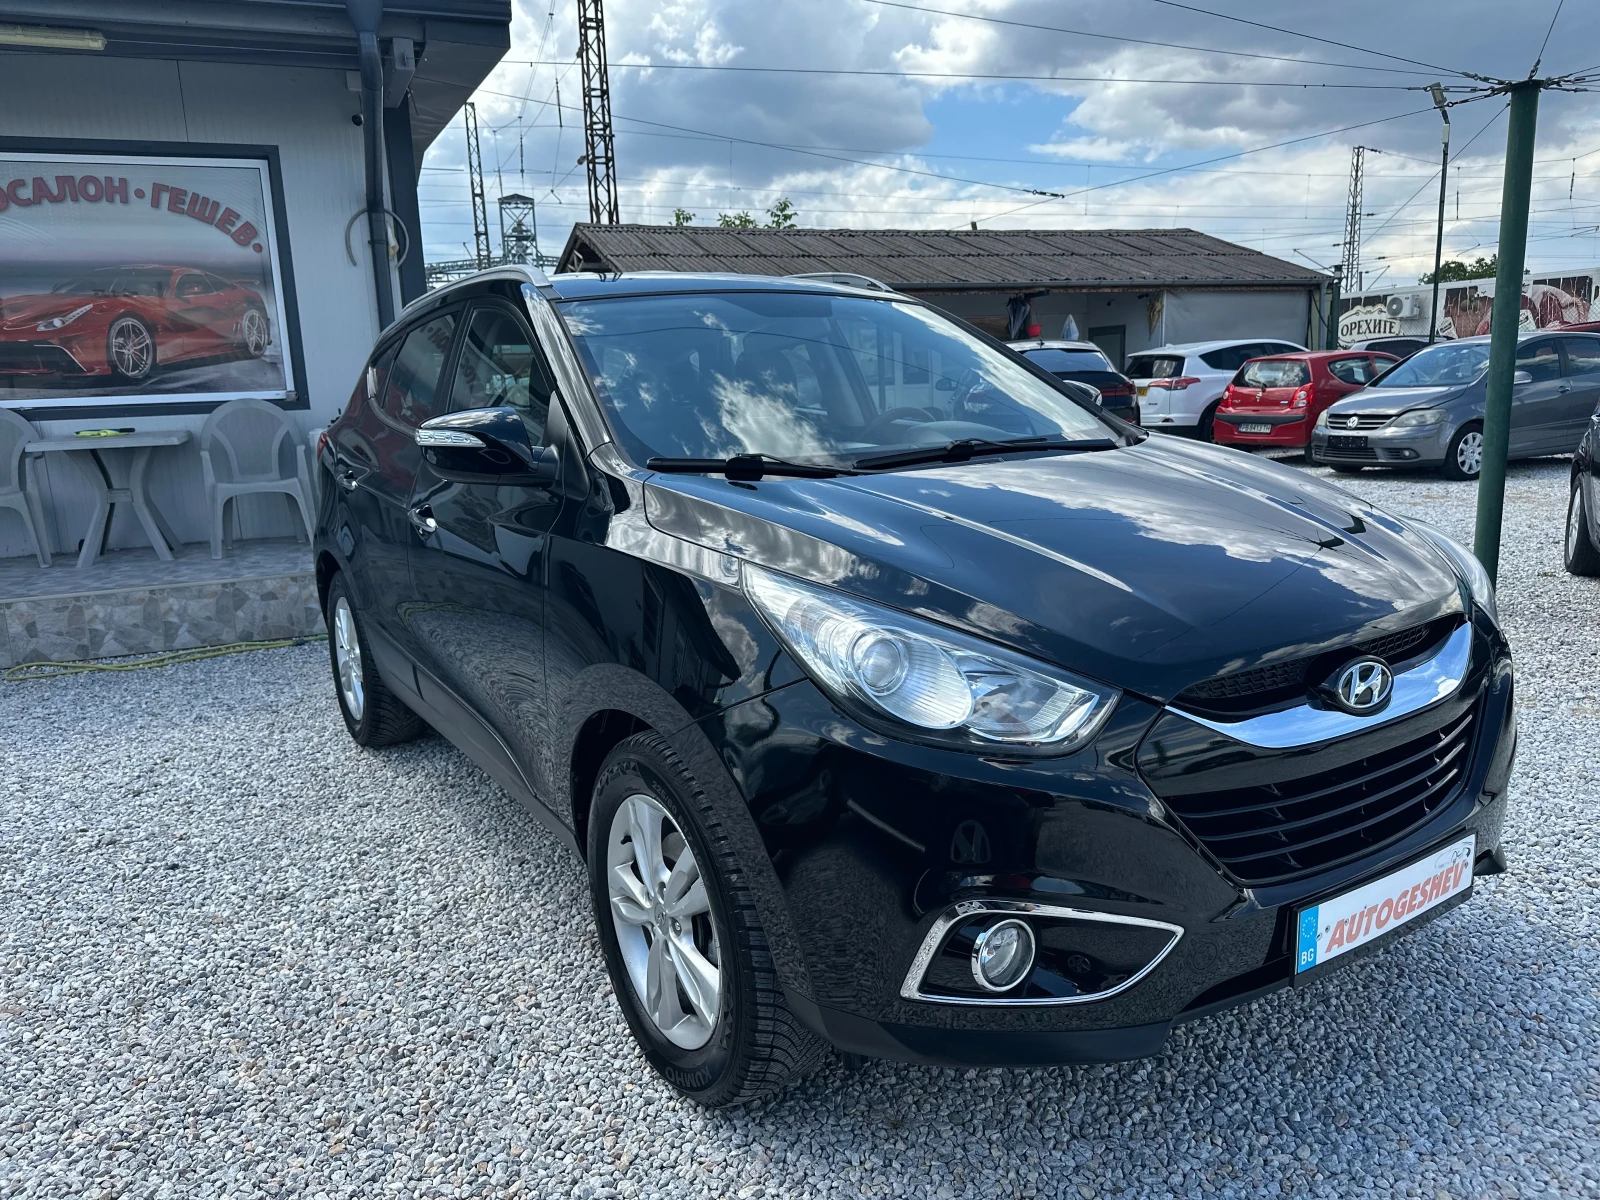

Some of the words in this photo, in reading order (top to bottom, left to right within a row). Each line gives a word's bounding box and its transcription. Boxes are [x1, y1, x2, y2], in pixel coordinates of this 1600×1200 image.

[1341, 318, 1396, 337] ОРЕХИТЕ
[1325, 859, 1467, 953] AUTOGESHEV
[1301, 948, 1315, 965] BG
[664, 1065, 713, 1088] KUMHO
